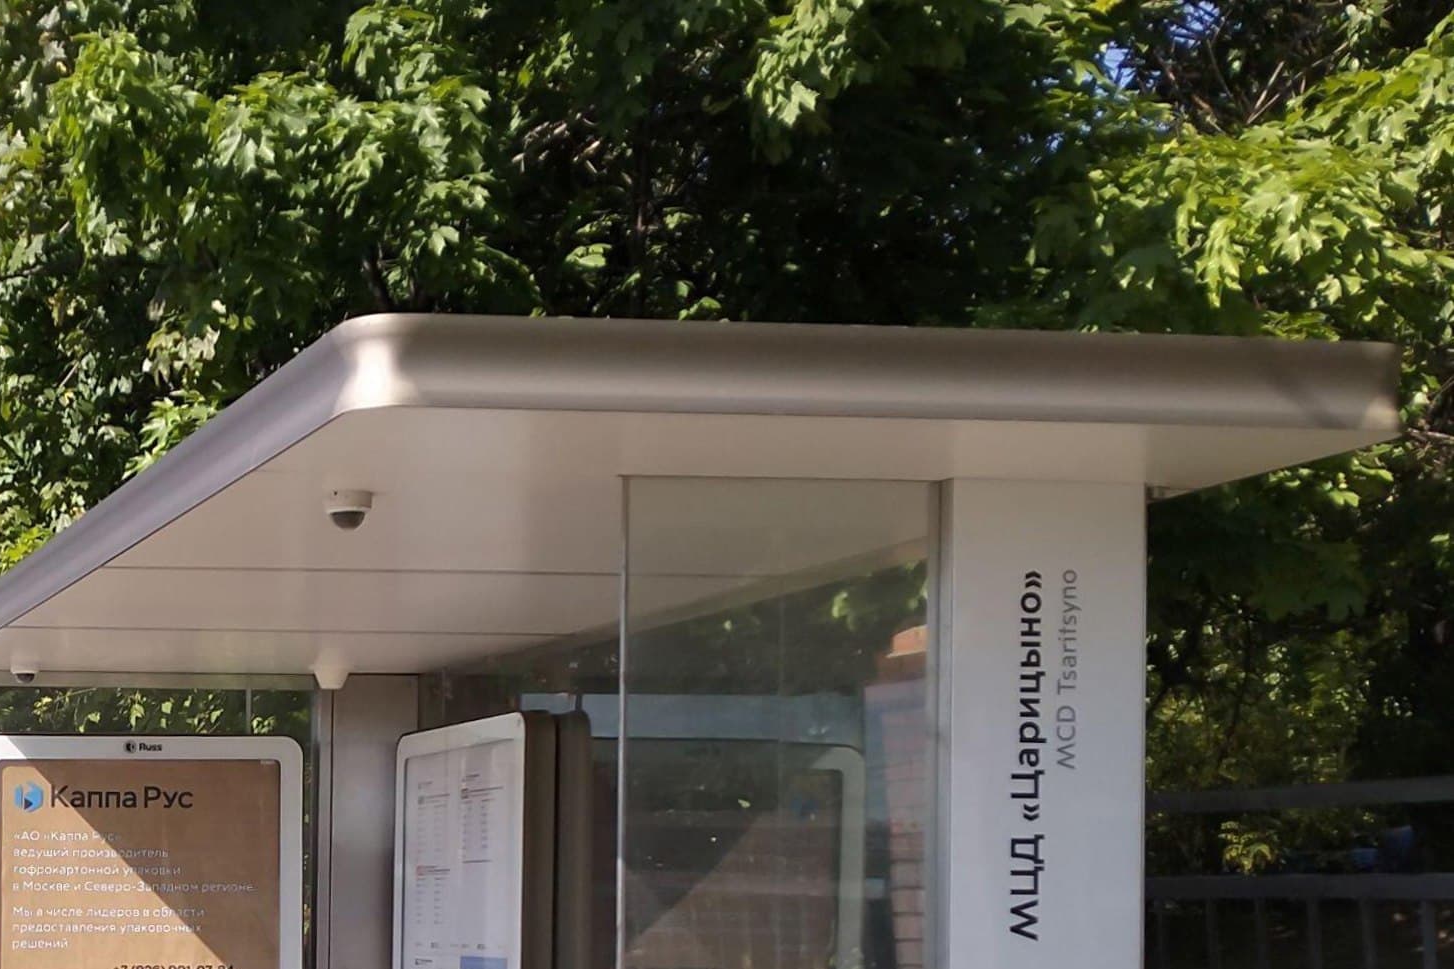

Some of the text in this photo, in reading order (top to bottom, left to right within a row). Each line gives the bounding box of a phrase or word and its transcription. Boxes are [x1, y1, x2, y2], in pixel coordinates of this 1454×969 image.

[1057, 569, 1082, 769] MCD Tsaritsyno
[1009, 570, 1046, 941] МЦД «Царицыно»
[50, 785, 194, 809] Каппа Рус
[13, 847, 169, 858] ведущий производитель
[13, 864, 181, 877] гофрокартонной упаковки
[22, 881, 71, 892] Москве
[12, 906, 33, 917] Мы
[46, 908, 83, 917] числе
[86, 908, 140, 918] лидеров
[153, 906, 205, 918] области
[12, 923, 202, 934] предоставления упаковочных
[12, 938, 68, 950] решений
